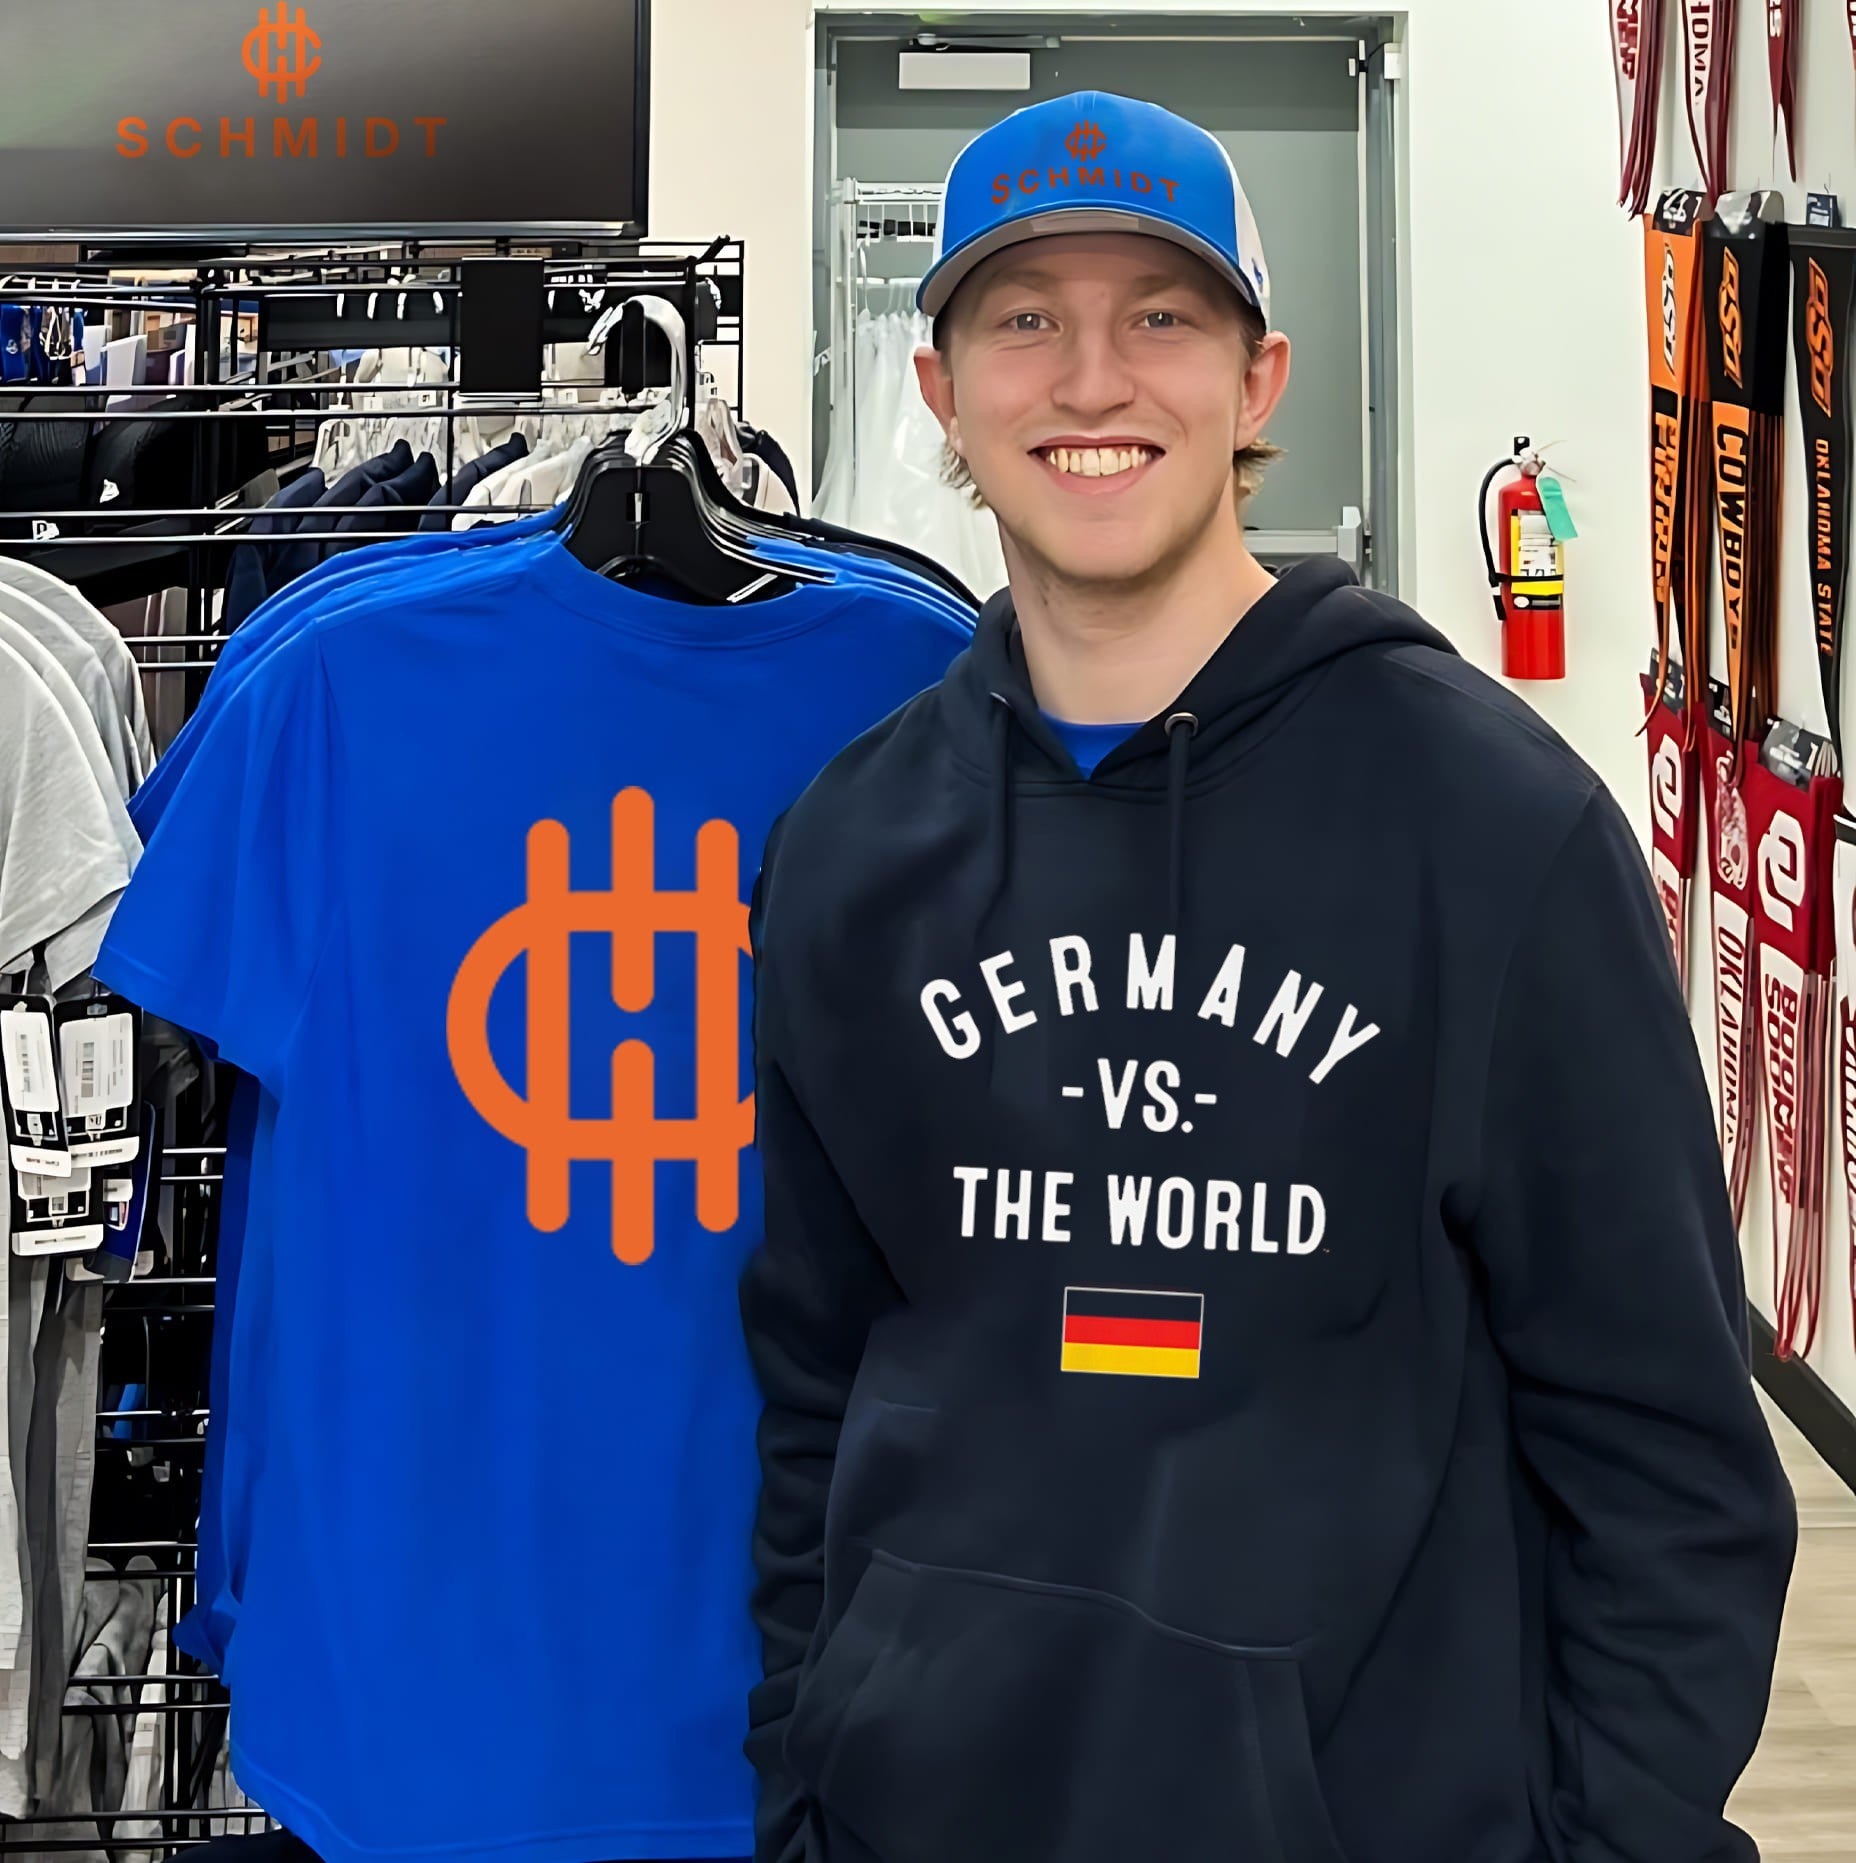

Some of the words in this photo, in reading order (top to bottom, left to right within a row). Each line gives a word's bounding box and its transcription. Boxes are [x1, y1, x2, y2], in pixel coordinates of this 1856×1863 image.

[115, 116, 448, 159] SCHMIDT
[991, 166, 1180, 205] SCHMIDT
[1815, 438, 1832, 571] OKLAHOMA
[1816, 583, 1834, 656] STATE
[920, 932, 1381, 1085] GERMANY
[1718, 926, 1746, 1144] OKLAHOMA
[953, 1166, 1074, 1242] THE
[1107, 1175, 1327, 1255] WORLD
